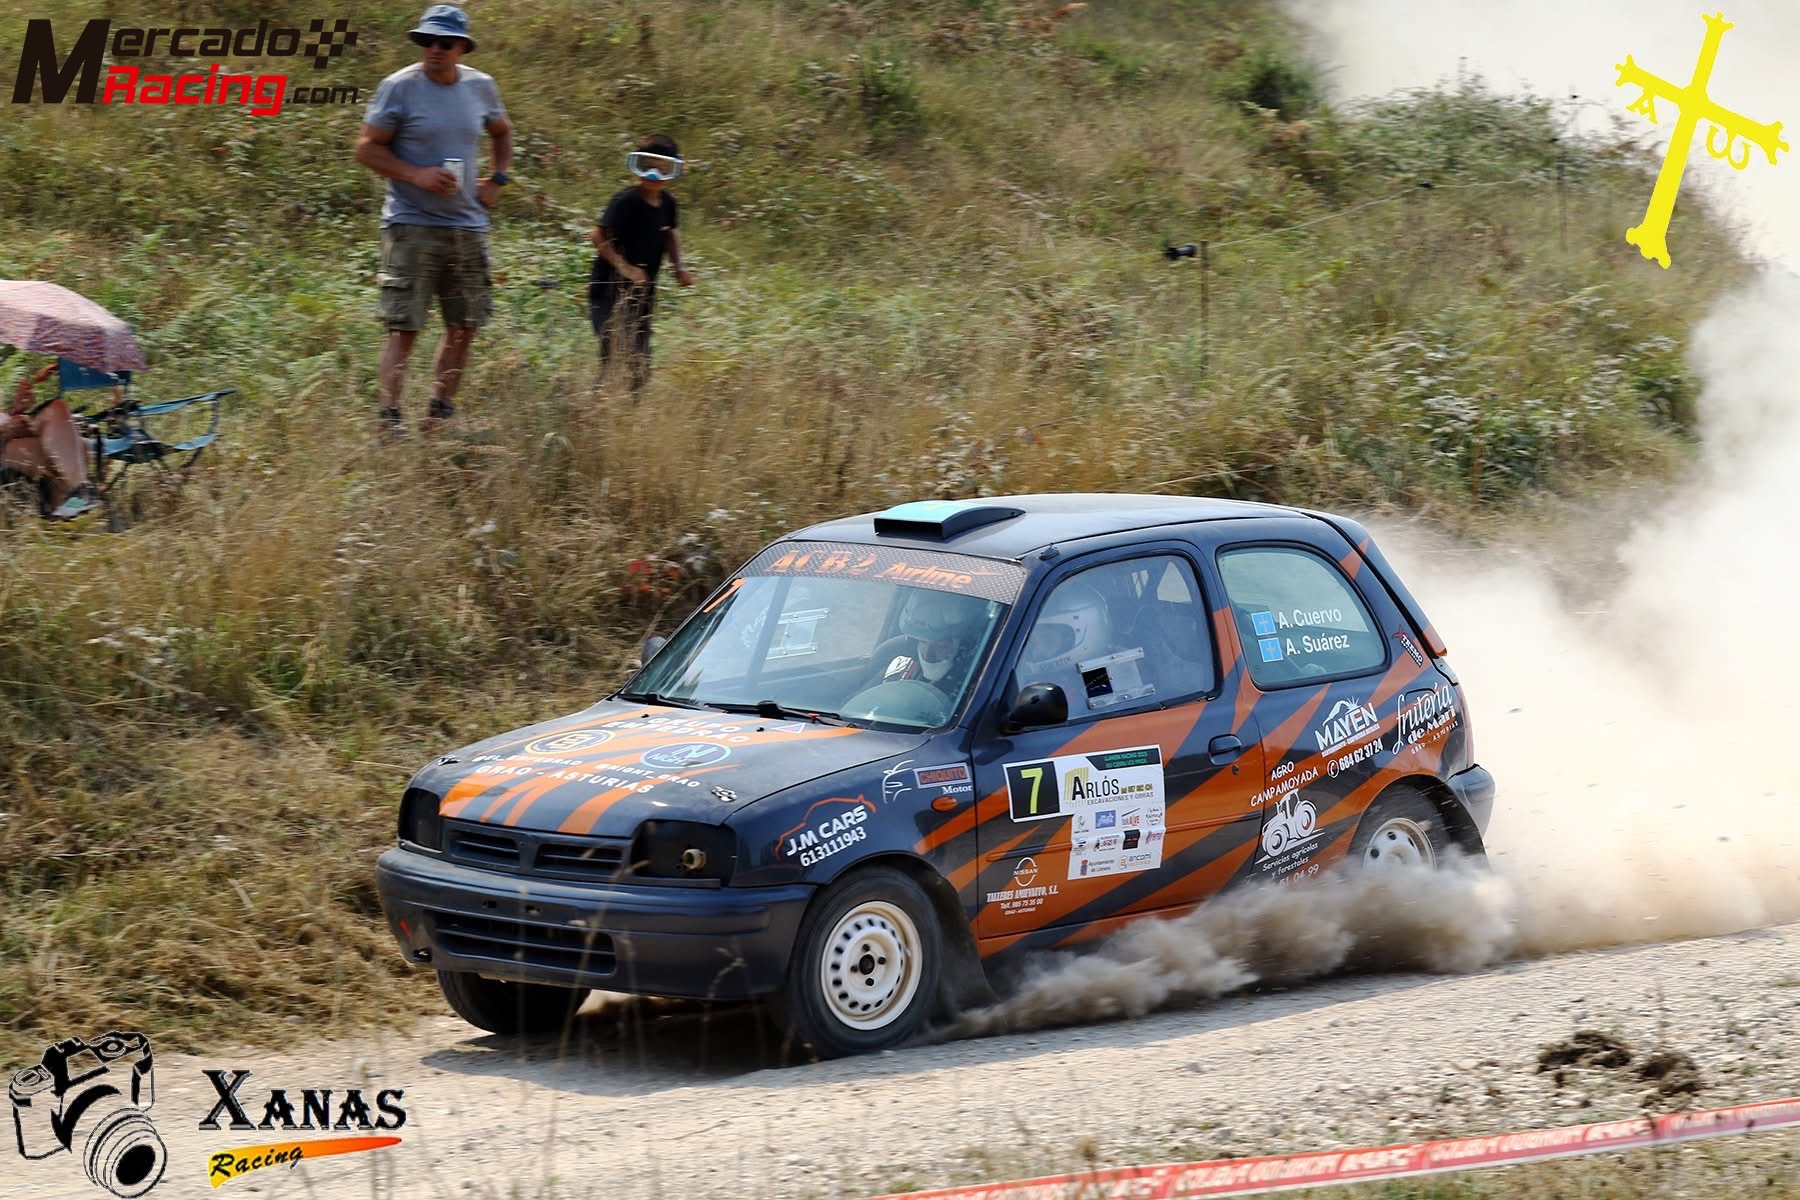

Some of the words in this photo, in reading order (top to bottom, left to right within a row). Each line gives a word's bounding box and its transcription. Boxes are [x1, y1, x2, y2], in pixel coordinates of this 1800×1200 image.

[873, 562, 975, 589] Airline
[1278, 612, 1293, 629] A.
[1293, 608, 1342, 627] Cuervo
[1286, 638, 1301, 656] A.
[1302, 633, 1350, 653] Suárez
[647, 717, 742, 733] GRUPO
[1315, 703, 1378, 751] MAYEN
[1392, 682, 1453, 755] frutería
[1407, 724, 1426, 745] de
[1426, 704, 1457, 734] Mari
[601, 721, 751, 744] EMPEDRAO
[1433, 721, 1459, 742] ASTURIAS
[1338, 756, 1354, 771] 684
[1353, 750, 1365, 764] 62
[1365, 744, 1374, 759] 37
[1373, 738, 1384, 754] 24
[474, 765, 534, 776] GRAO
[548, 771, 656, 794] ASTURIAS
[1271, 761, 1295, 781] AGRO
[942, 784, 973, 795] Motor
[1020, 766, 1043, 814] 7
[1250, 766, 1319, 807] CAMPAMOYADA
[1087, 795, 1129, 806] EXCAVACIONES
[1134, 792, 1154, 800] OBRAS
[786, 833, 818, 857] J.M
[818, 804, 868, 839] CARS
[799, 826, 867, 867] 613111943
[1262, 854, 1290, 872] Servicios
[1277, 856, 1310, 874] forestales
[1307, 863, 1320, 877] 99
